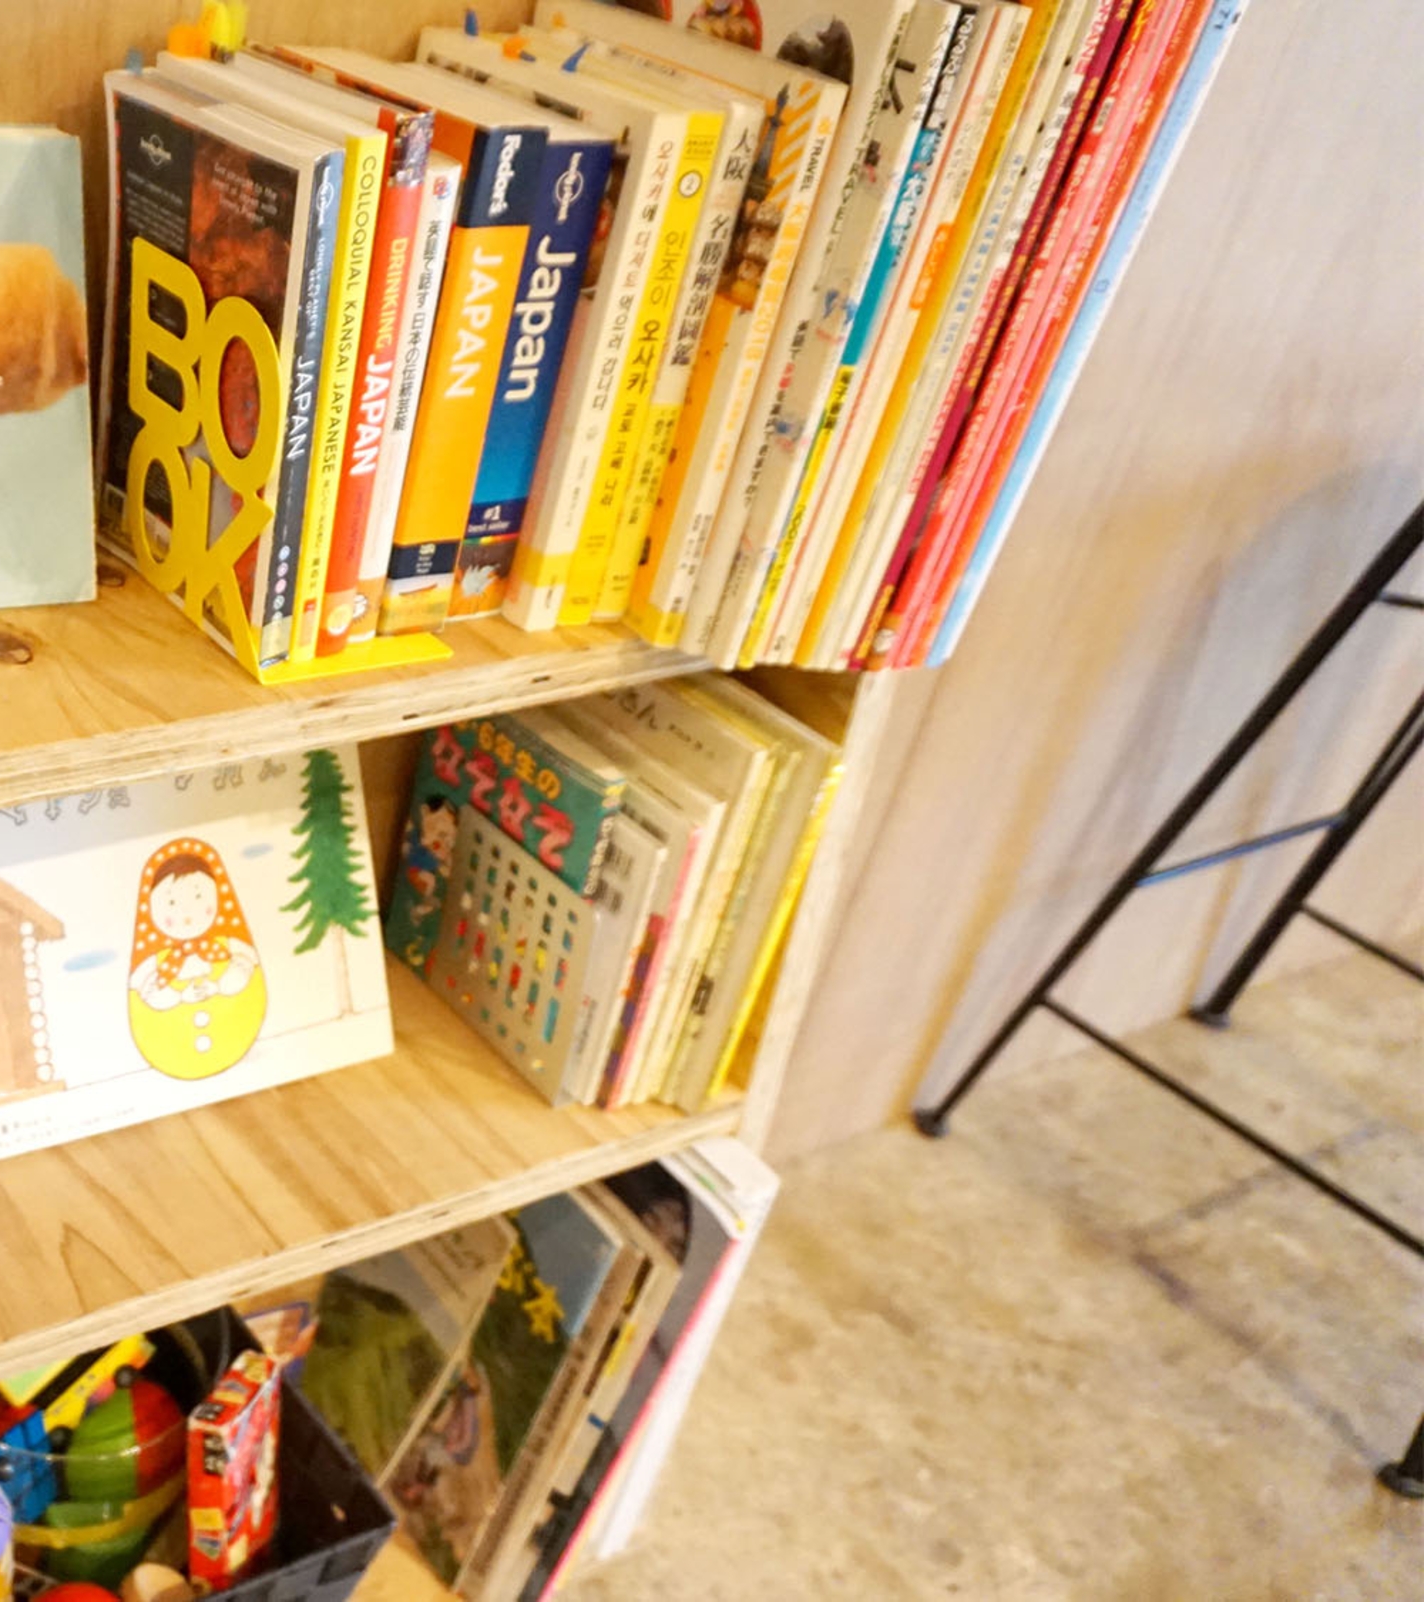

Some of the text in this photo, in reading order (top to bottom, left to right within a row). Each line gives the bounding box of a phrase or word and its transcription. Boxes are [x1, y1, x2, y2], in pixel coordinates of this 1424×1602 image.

[488, 133, 523, 218] Fodor's
[799, 136, 826, 192] TRAVEL
[323, 155, 377, 473] COLLOQUIAL KANSAI JAPANESE
[504, 235, 578, 402] Japan
[649, 230, 686, 308] 인조이
[350, 238, 408, 476] DRINKING JAPAN
[444, 248, 504, 399] JAPAN
[626, 319, 661, 395] 오사카
[286, 356, 315, 460] JAPAN
